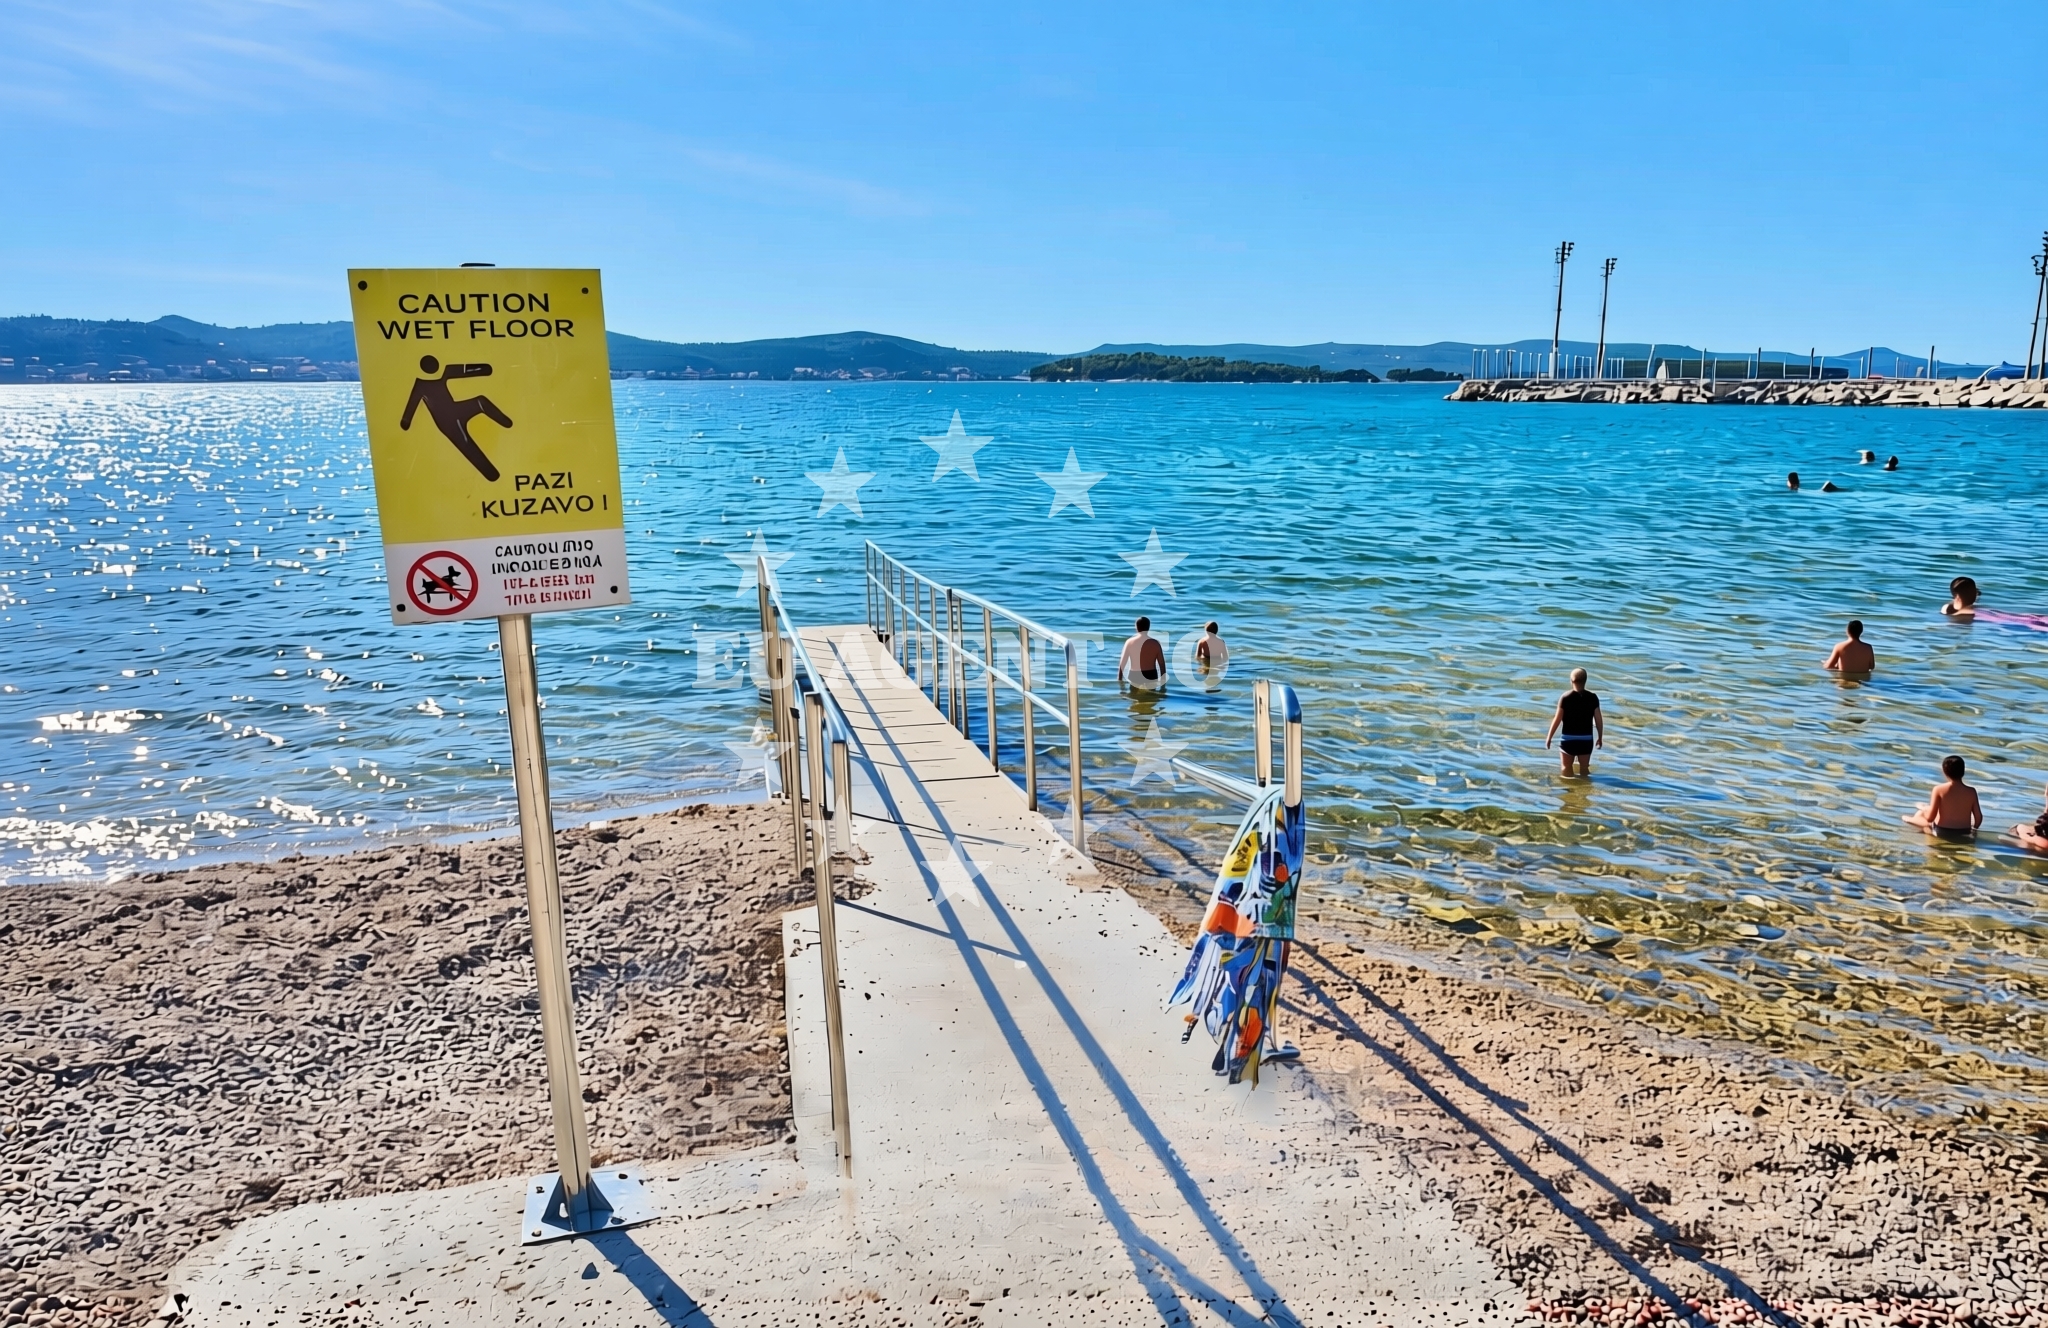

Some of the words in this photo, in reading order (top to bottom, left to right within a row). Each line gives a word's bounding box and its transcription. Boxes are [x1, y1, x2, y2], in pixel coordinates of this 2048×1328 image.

[398, 293, 550, 314] CAUTION
[377, 320, 455, 340] WET
[469, 319, 575, 339] FLOOR
[514, 471, 573, 491] PAZI
[481, 495, 594, 518] KUZAVO
